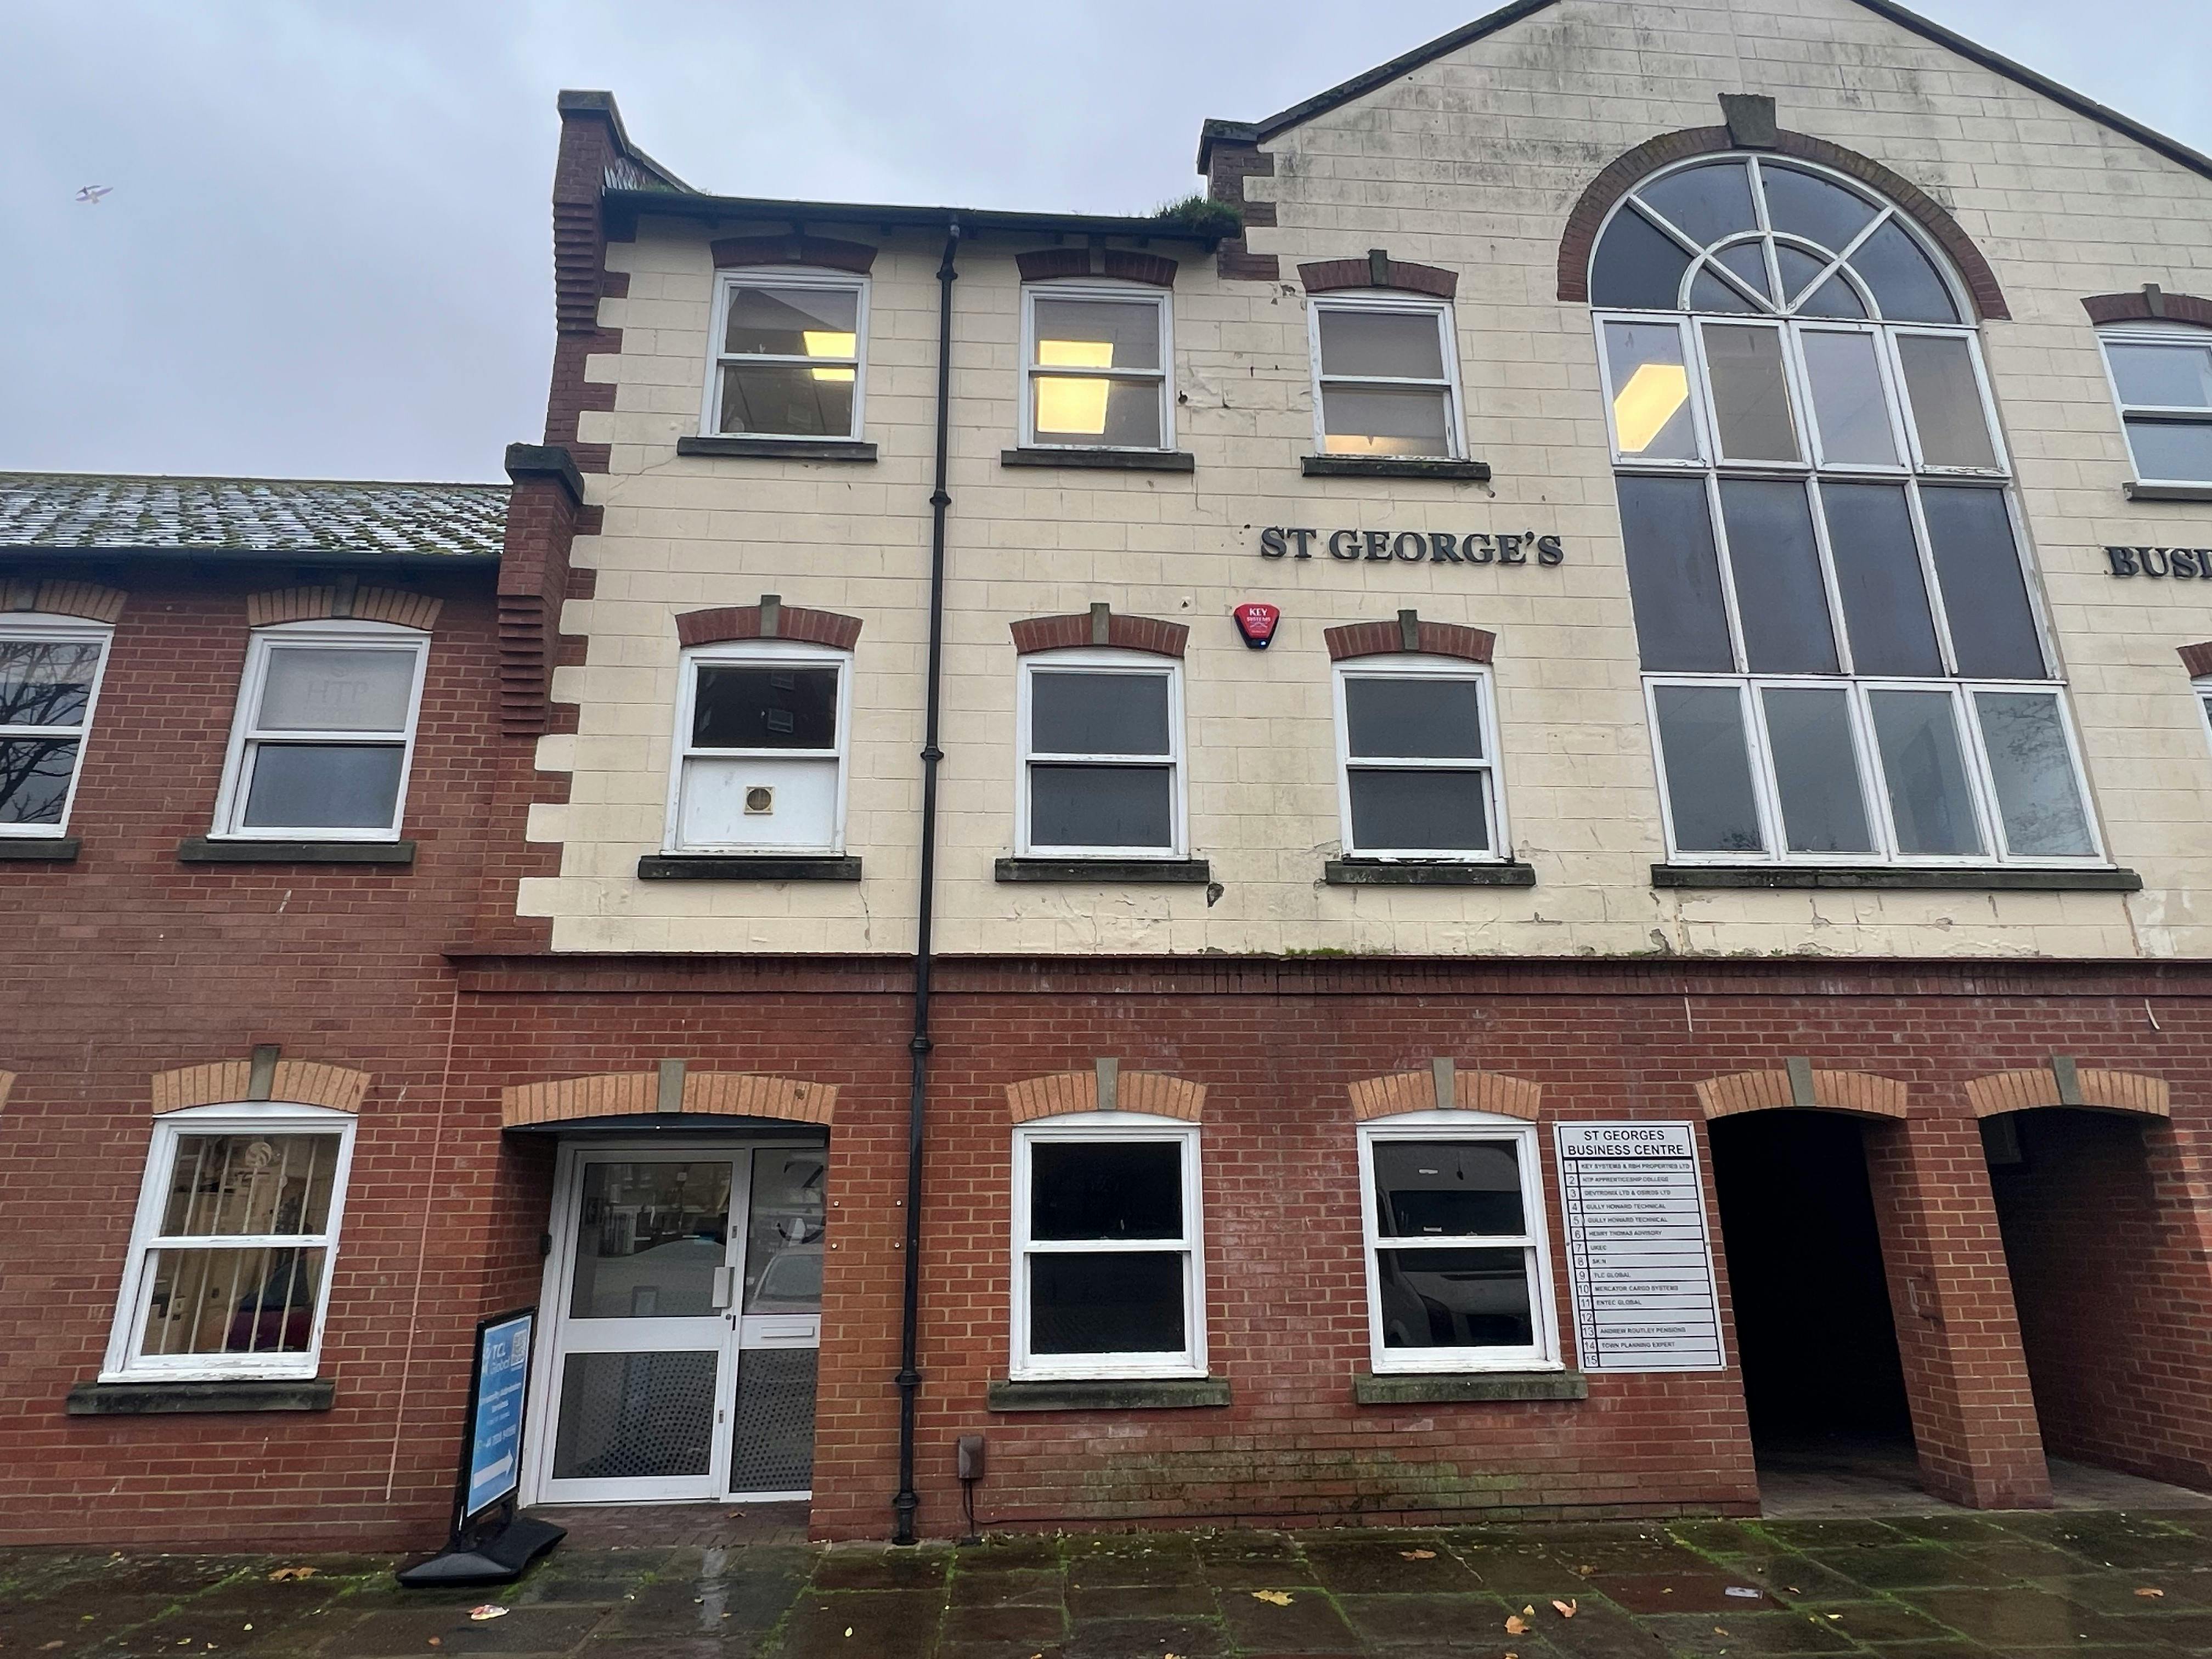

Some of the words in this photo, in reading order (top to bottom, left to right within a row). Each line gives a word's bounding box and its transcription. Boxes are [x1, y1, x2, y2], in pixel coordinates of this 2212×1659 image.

[1261, 527, 1317, 558] ST
[1329, 530, 1564, 565] GEORGE'S
[1584, 1130, 1599, 1141] ST
[1603, 1130, 1665, 1141] GEORGES
[1568, 1145, 1630, 1155] BUSINESS
[1634, 1144, 1684, 1155] CENTRE
[1568, 1163, 1572, 1171] 1
[1569, 1176, 1575, 1184] 2
[1570, 1189, 1576, 1198] 3
[1573, 1216, 1579, 1224] 5
[1575, 1230, 1581, 1239] 6
[1576, 1244, 1581, 1252] 7
[1578, 1257, 1584, 1266] 8
[1579, 1271, 1585, 1280] 9
[1578, 1285, 1589, 1294] 10
[1581, 1299, 1590, 1307] 11
[1582, 1313, 1592, 1322] 12
[1583, 1327, 1594, 1336] 13
[1584, 1341, 1595, 1350] 14
[1587, 1356, 1597, 1365] 15
